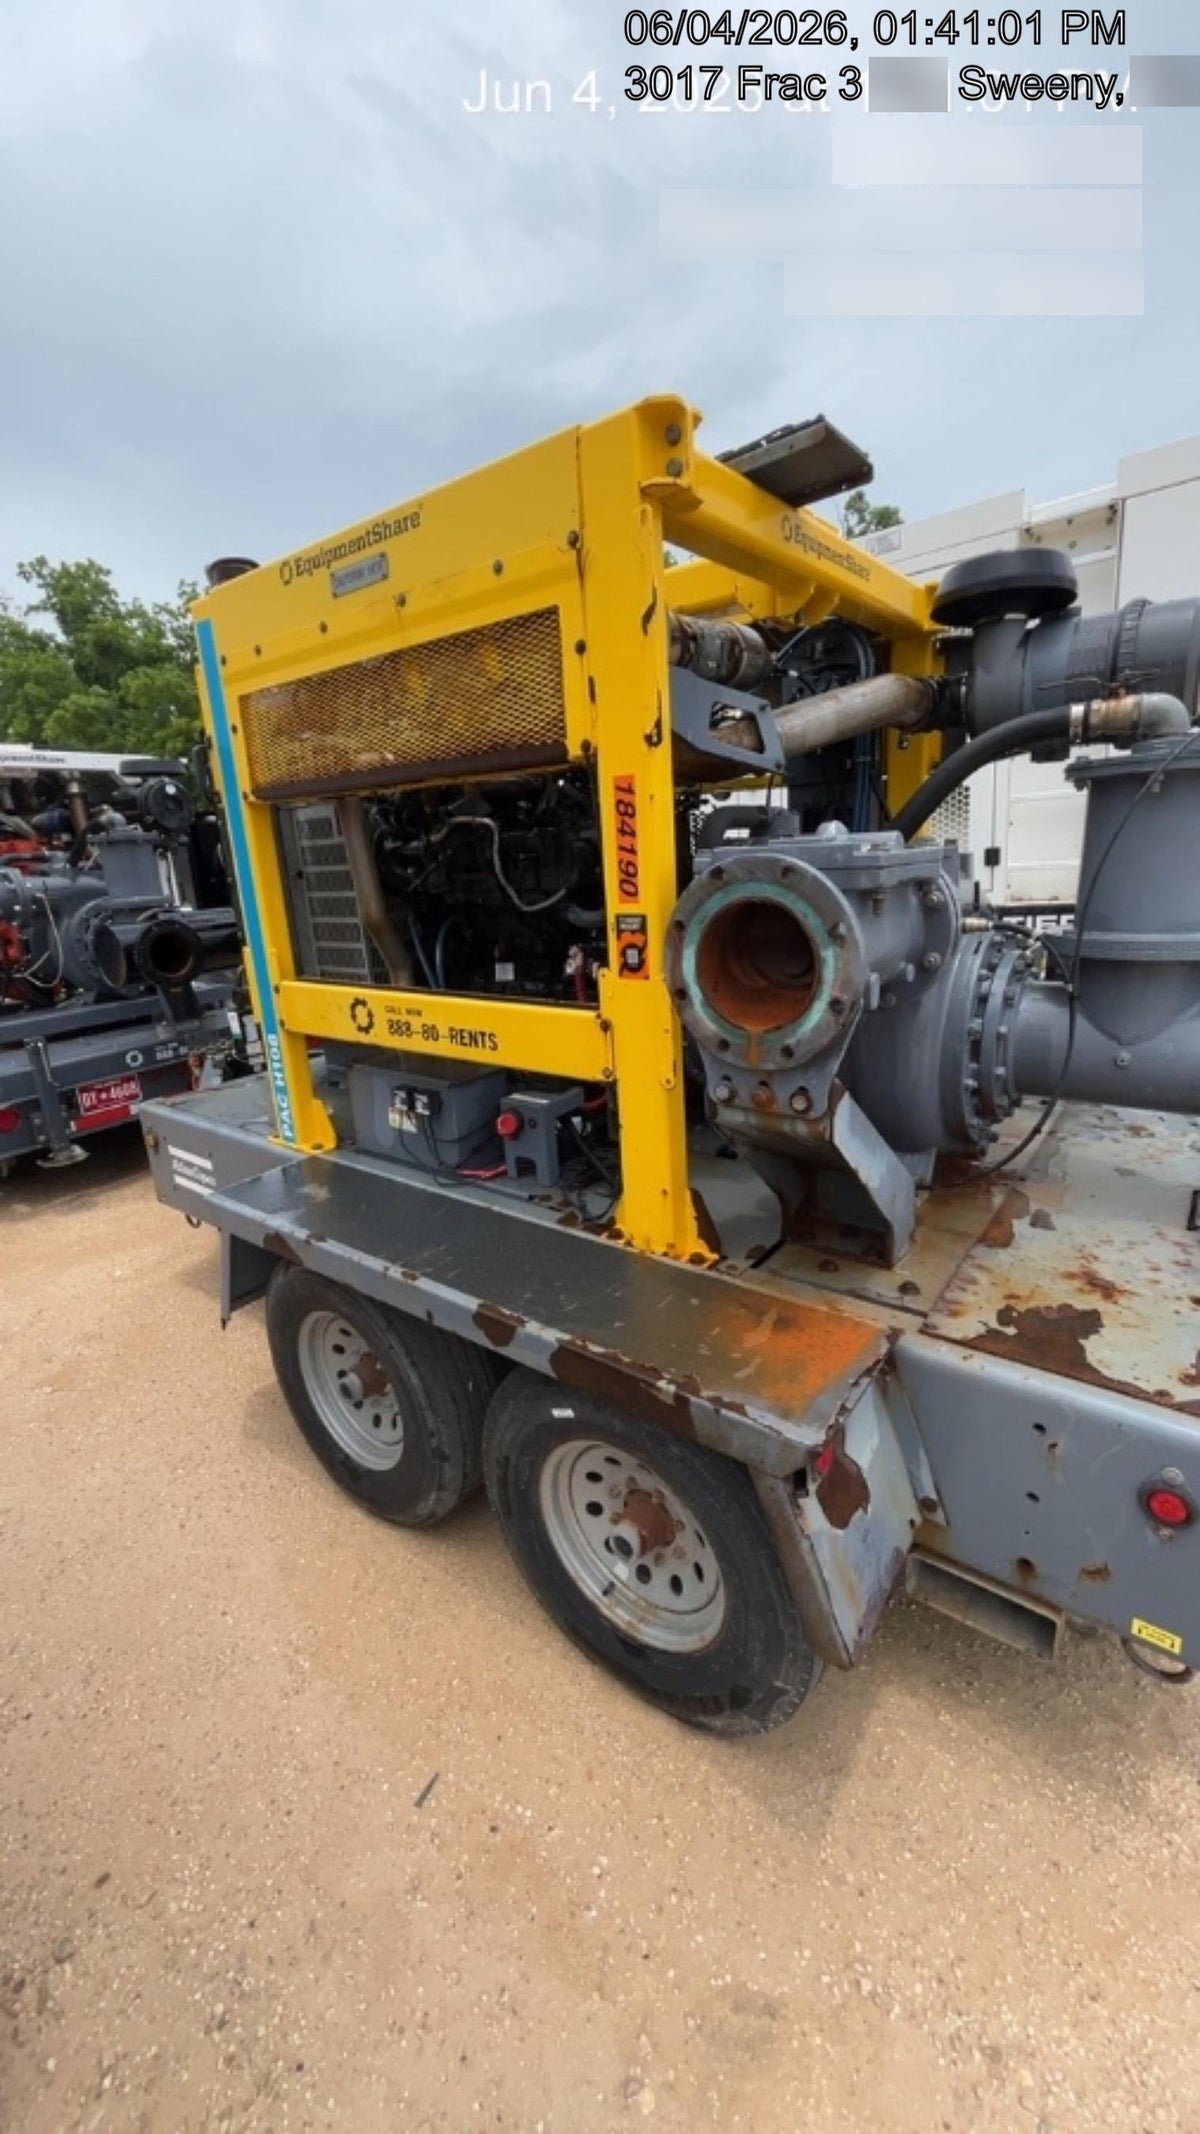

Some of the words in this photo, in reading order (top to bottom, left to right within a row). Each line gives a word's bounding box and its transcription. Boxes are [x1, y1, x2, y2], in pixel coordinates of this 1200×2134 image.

[295, 510, 422, 576] EquipmentShare
[614, 781, 639, 898] 184190
[387, 1019, 498, 1051] 888-80-RENTS
[280, 1093, 294, 1138] PAC
